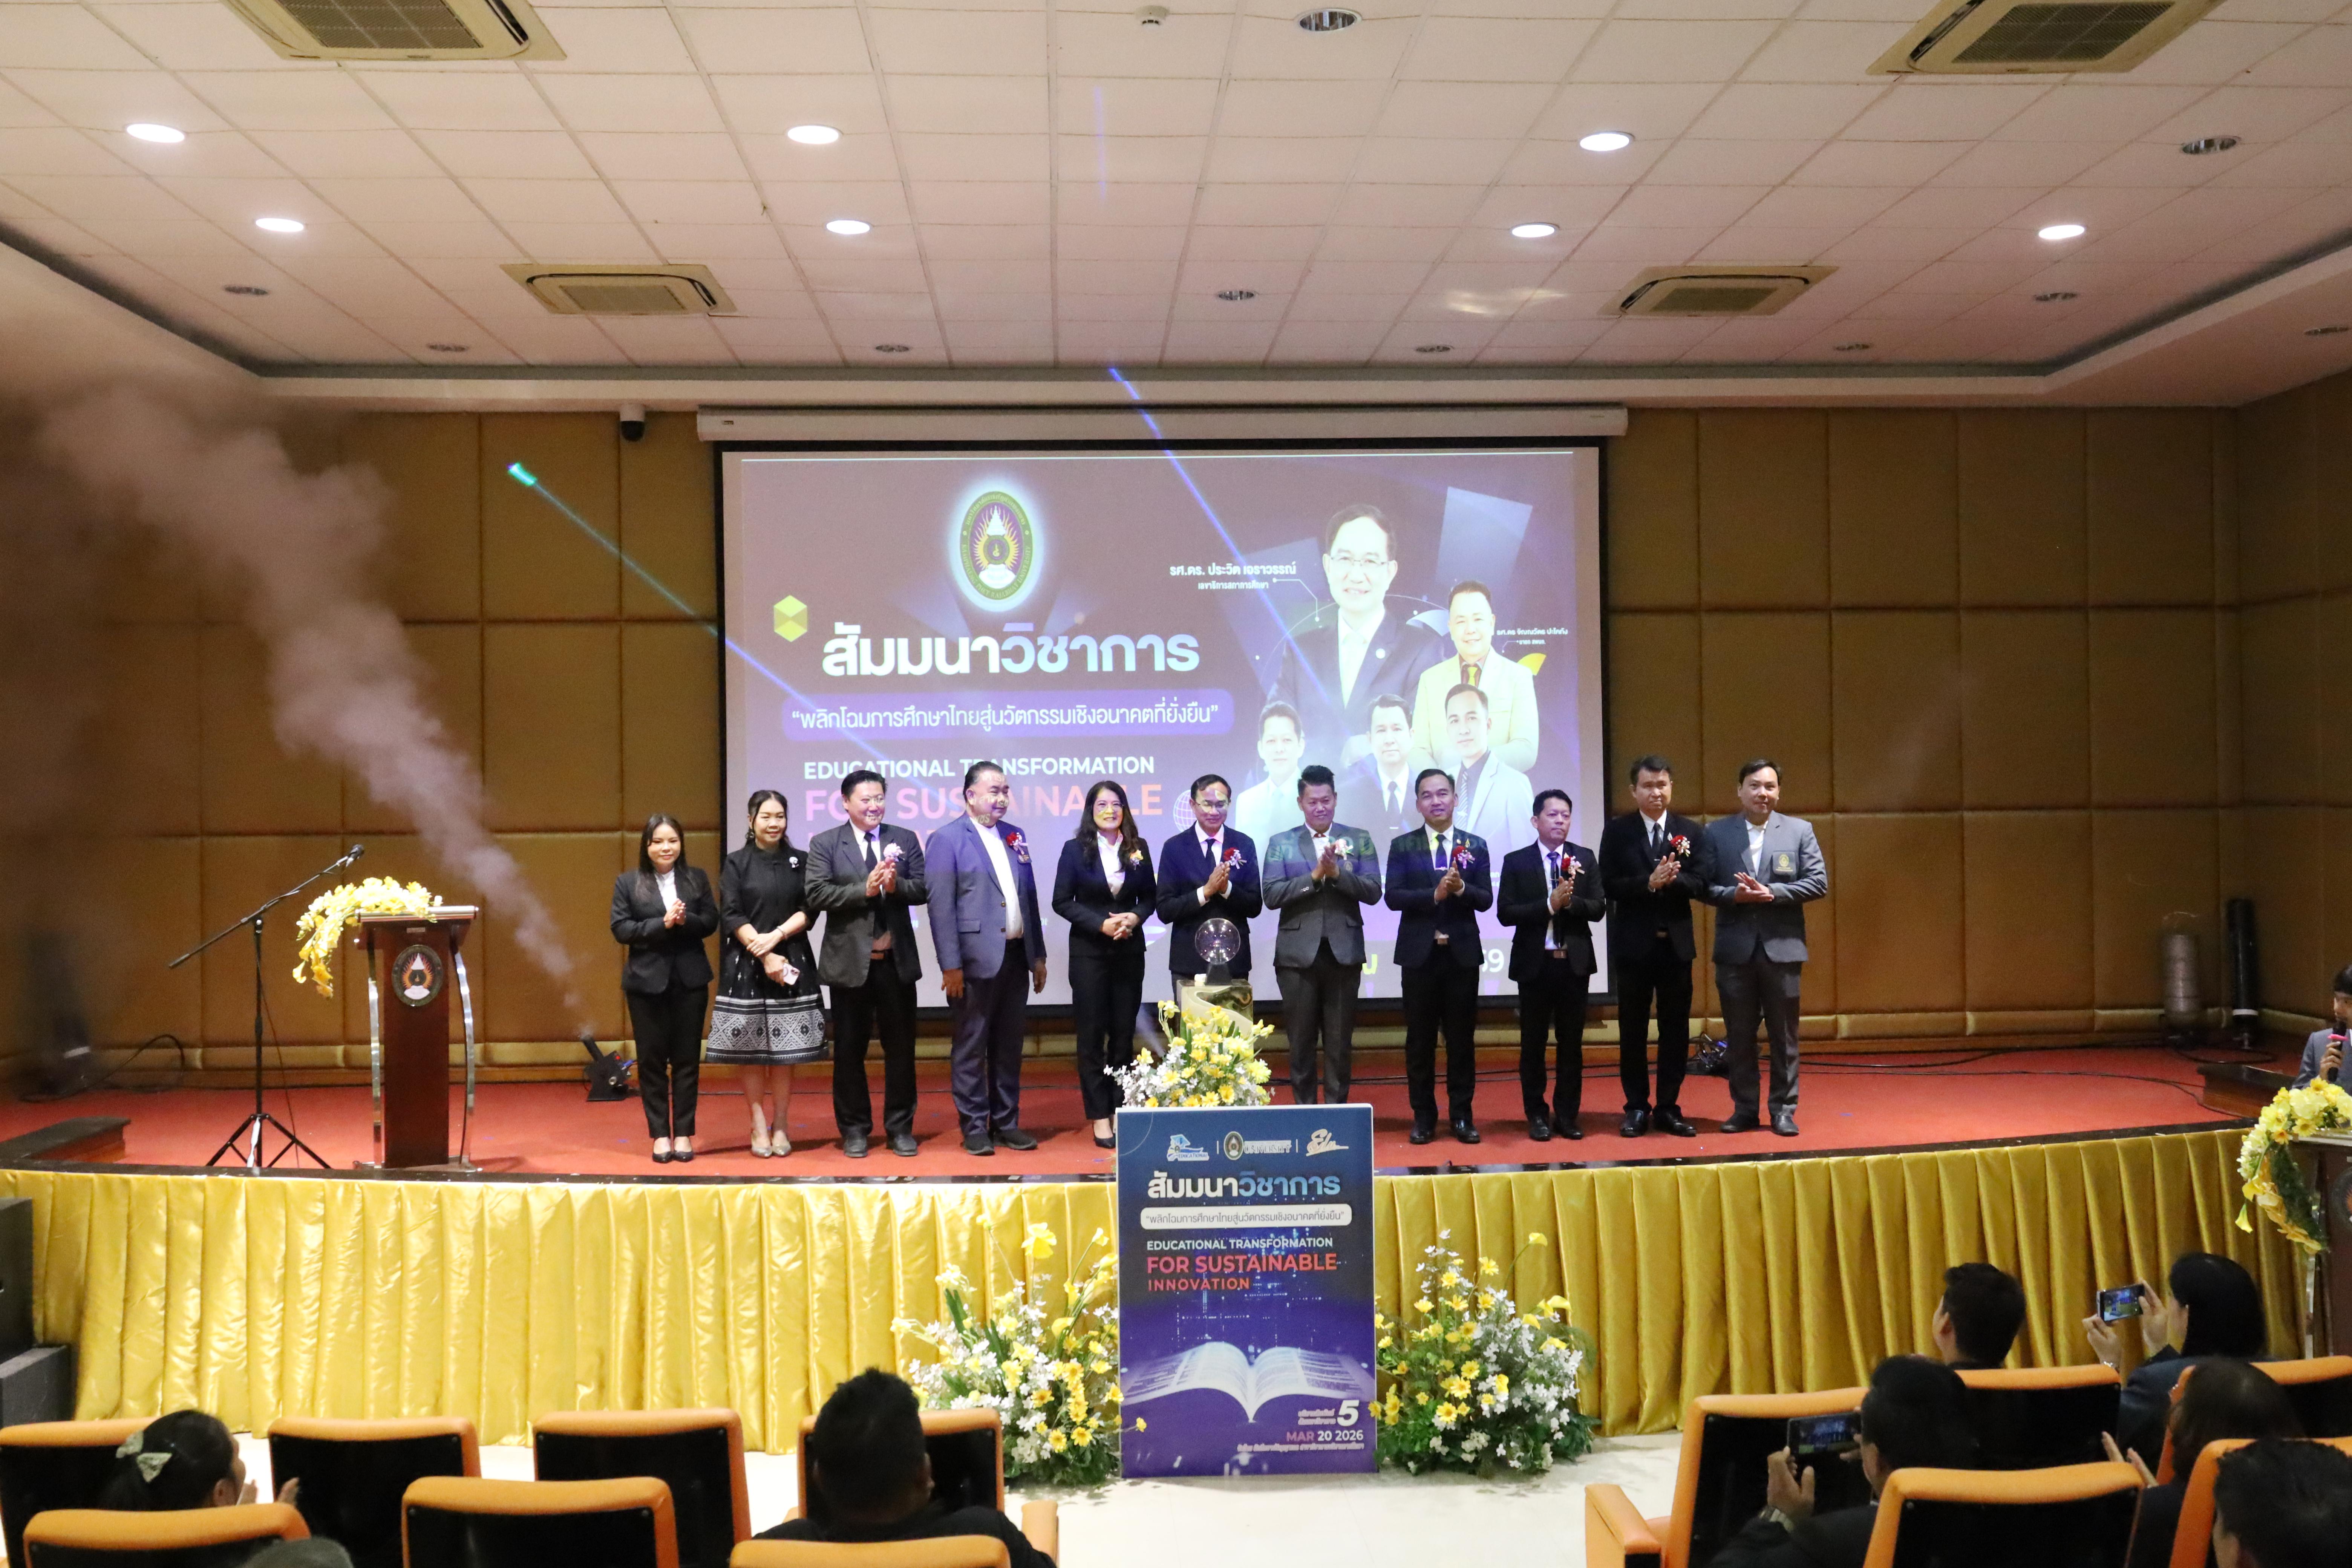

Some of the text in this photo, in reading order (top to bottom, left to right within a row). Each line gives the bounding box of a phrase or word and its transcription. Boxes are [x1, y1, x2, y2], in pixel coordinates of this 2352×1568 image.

[1170, 561, 1297, 576] รศ.ดร. ประวิต เอราวรรณ์
[822, 622, 1199, 676] สัมมนาวิชาการ
[1244, 1144, 1292, 1154] UNIVERSITY
[1147, 1170, 1341, 1199] สัมมนาวิชาการ
[1147, 1238, 1333, 1251] EDUCATIONAL TRANSFORMATION
[1147, 1253, 1337, 1274] FOR SUSTAINABLE
[1148, 1278, 1250, 1291] INNOVATION
[1337, 1400, 1360, 1426] 5
[1286, 1430, 1364, 1441] MAR 20 2026
